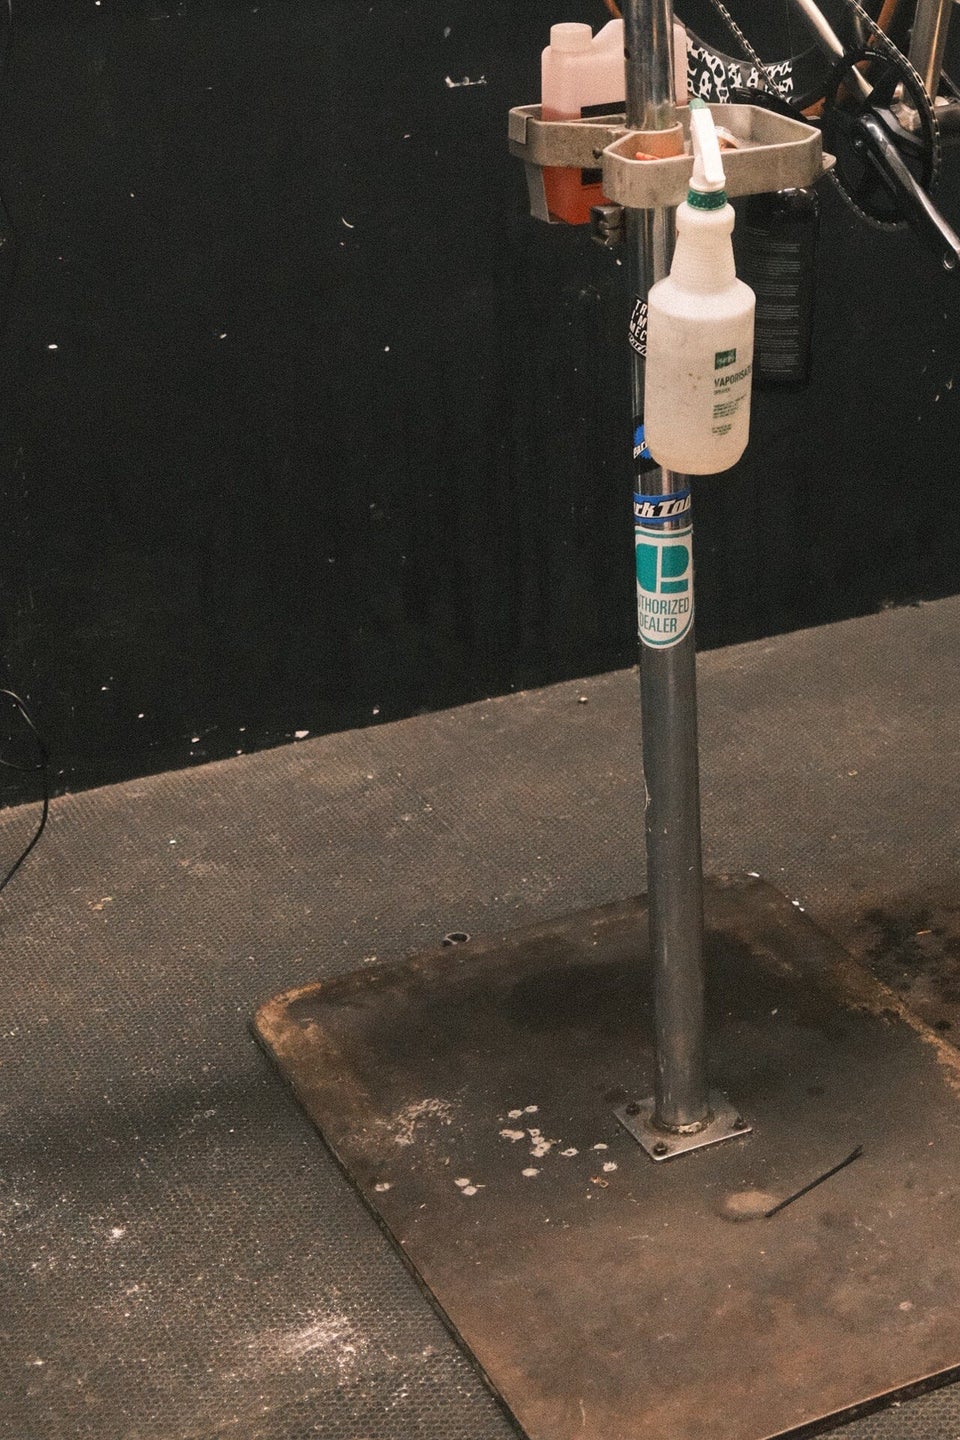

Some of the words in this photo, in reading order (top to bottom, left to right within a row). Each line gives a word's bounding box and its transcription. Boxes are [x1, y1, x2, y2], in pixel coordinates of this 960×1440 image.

[629, 320, 647, 341] MEC
[633, 501, 656, 517] rk
[638, 595, 690, 615] THORIZED
[639, 611, 678, 633] DEALER
